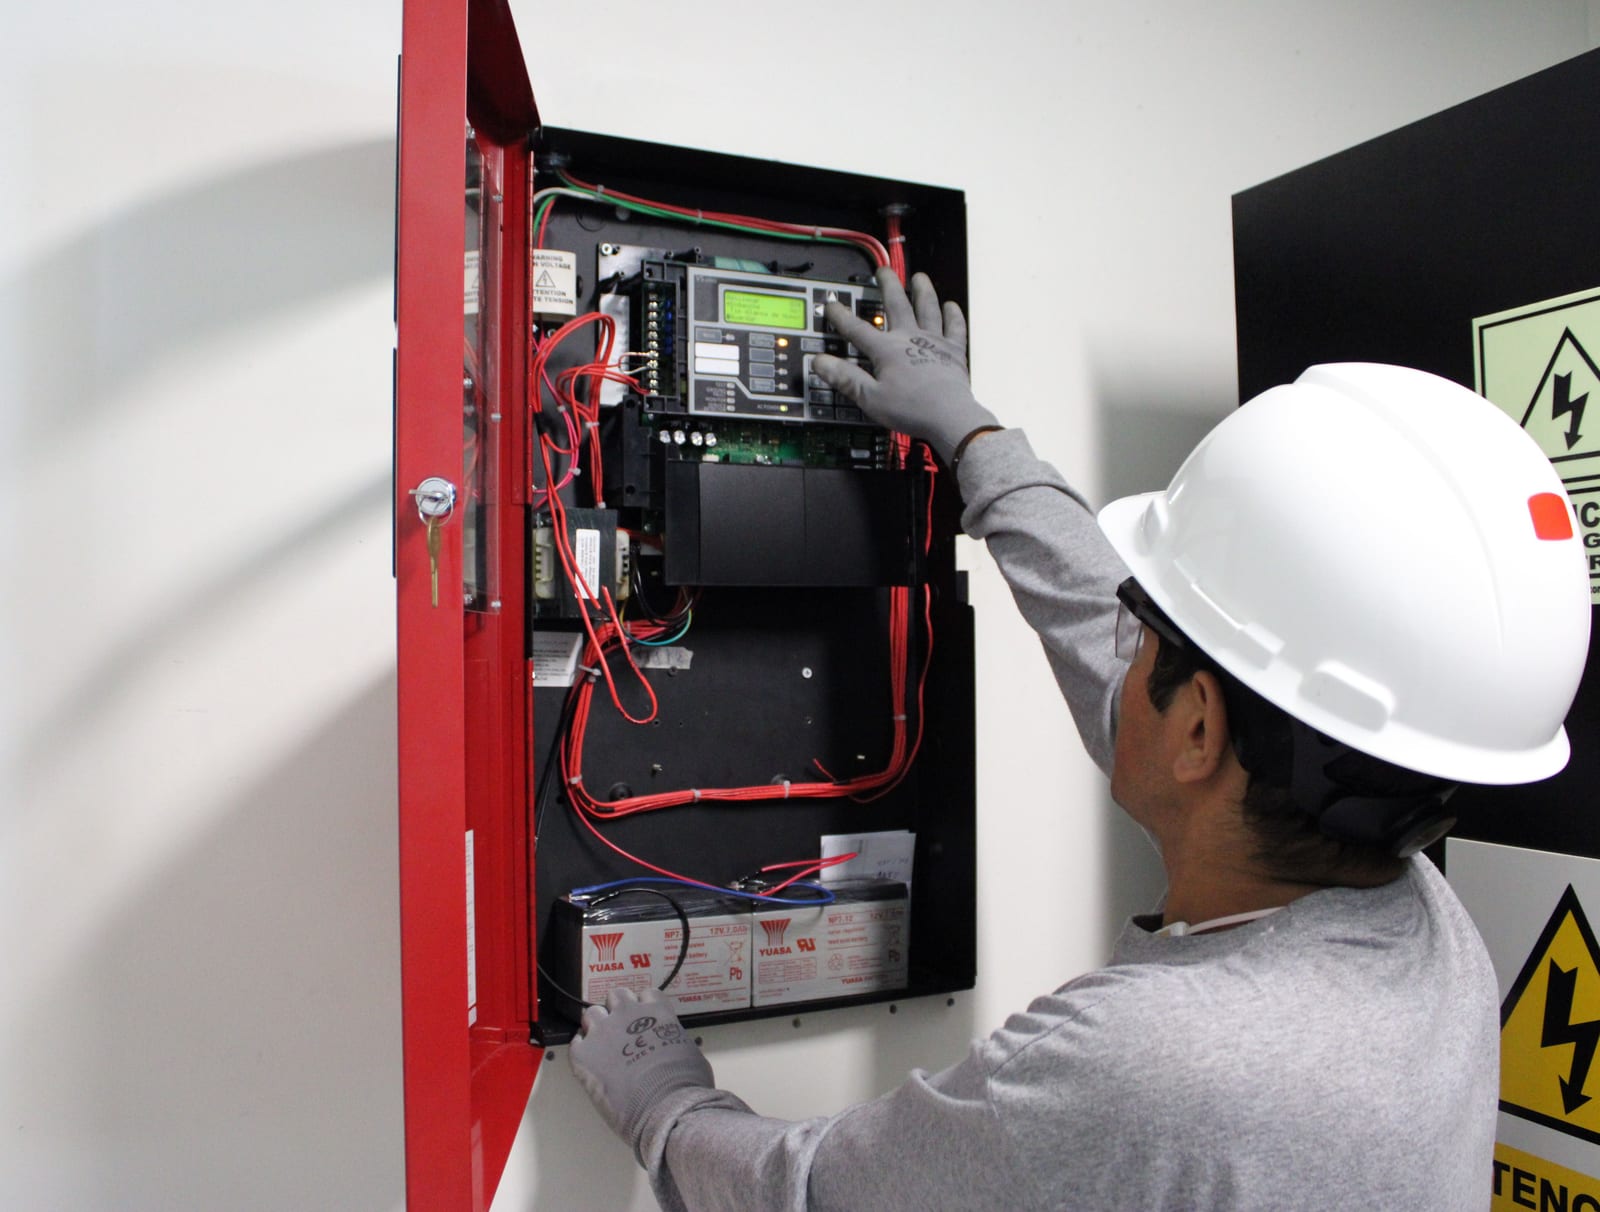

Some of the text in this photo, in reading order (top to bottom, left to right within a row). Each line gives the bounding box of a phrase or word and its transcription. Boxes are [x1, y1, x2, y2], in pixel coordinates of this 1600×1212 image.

[759, 947, 792, 956] YUASA
[588, 962, 625, 973] YUASA
[729, 967, 743, 981] Pb
